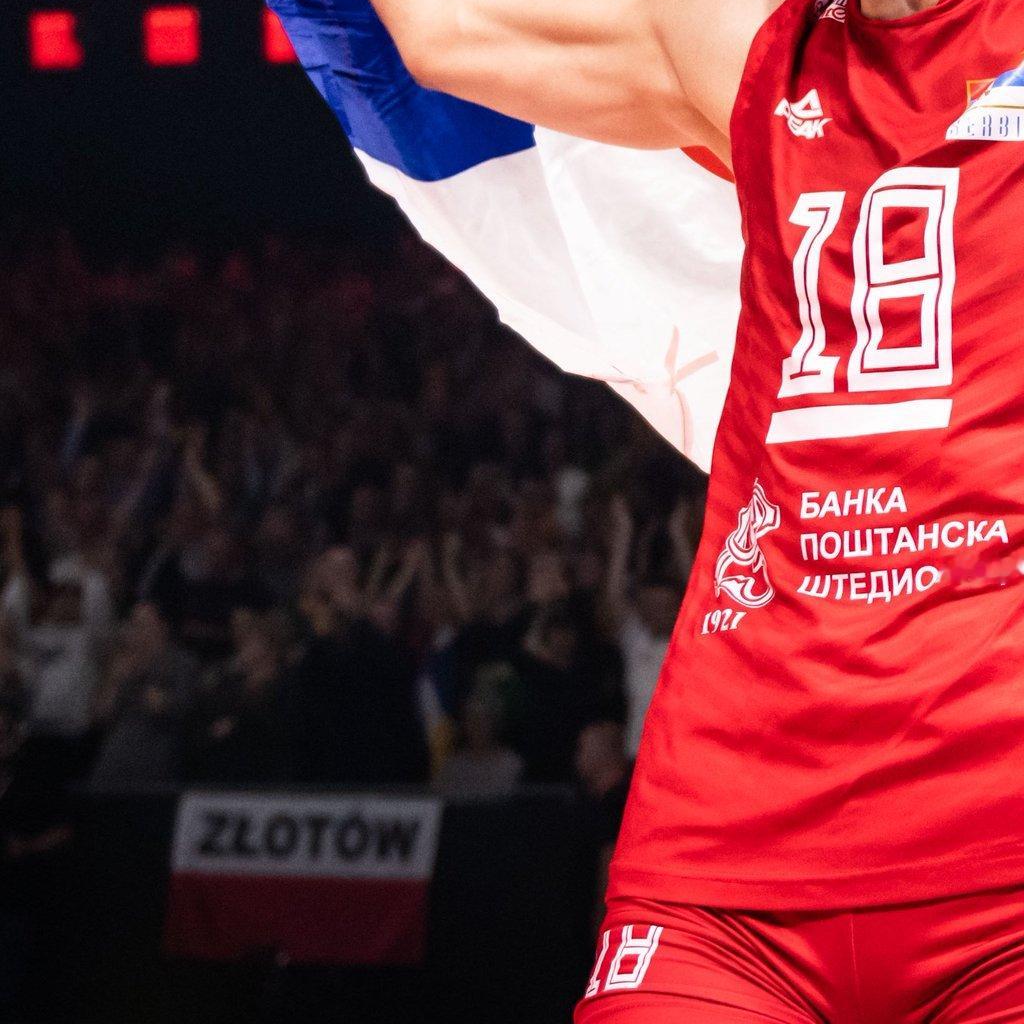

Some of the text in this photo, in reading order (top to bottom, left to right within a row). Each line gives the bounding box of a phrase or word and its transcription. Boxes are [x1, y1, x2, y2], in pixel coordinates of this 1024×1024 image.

[777, 166, 960, 398] 18
[800, 486, 908, 519] БАНКА
[800, 519, 1009, 561] ПОШТАНСКА
